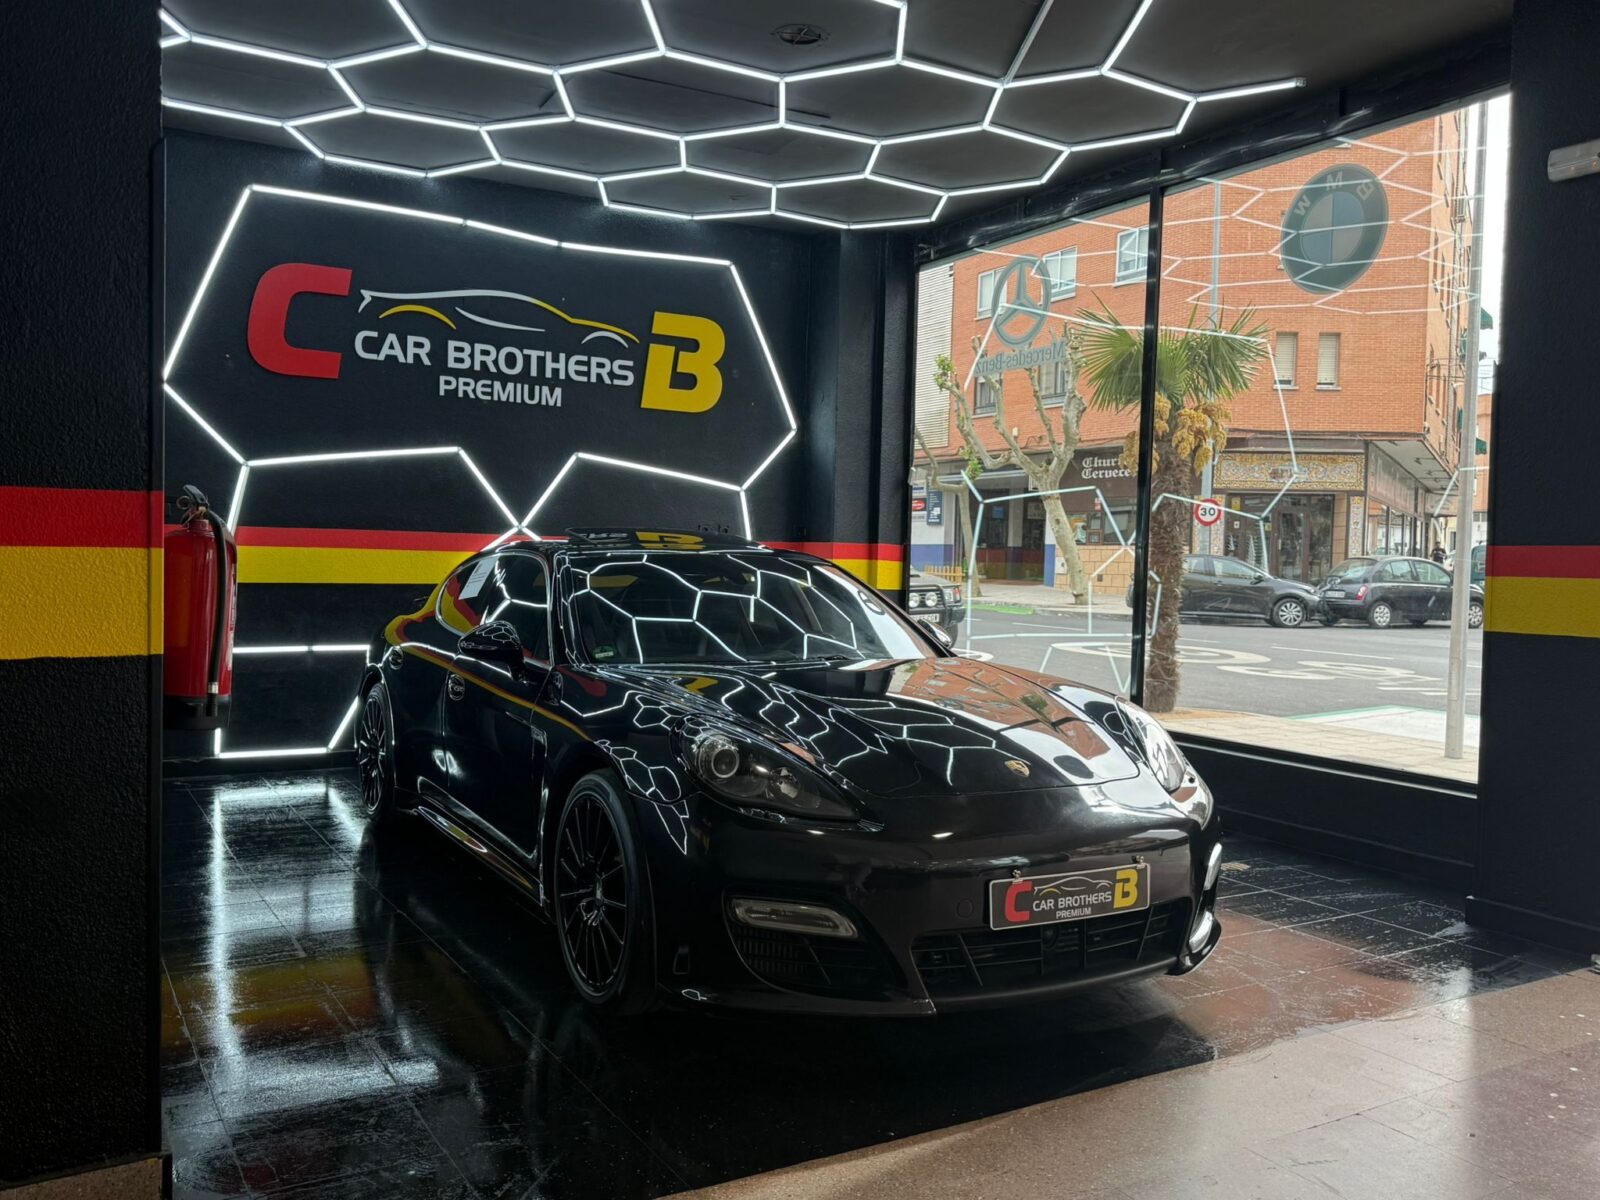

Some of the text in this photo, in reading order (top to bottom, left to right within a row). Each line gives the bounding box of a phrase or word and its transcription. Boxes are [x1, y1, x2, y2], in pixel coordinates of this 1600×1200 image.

[247, 262, 353, 379] C
[354, 330, 635, 387] CAR BROTHERS
[640, 311, 726, 413] B
[438, 374, 562, 407] PREMIUM
[1200, 507, 1216, 517] 30
[1032, 891, 1113, 912] CAR BROTHERS
[1055, 907, 1092, 919] PREMIUM
